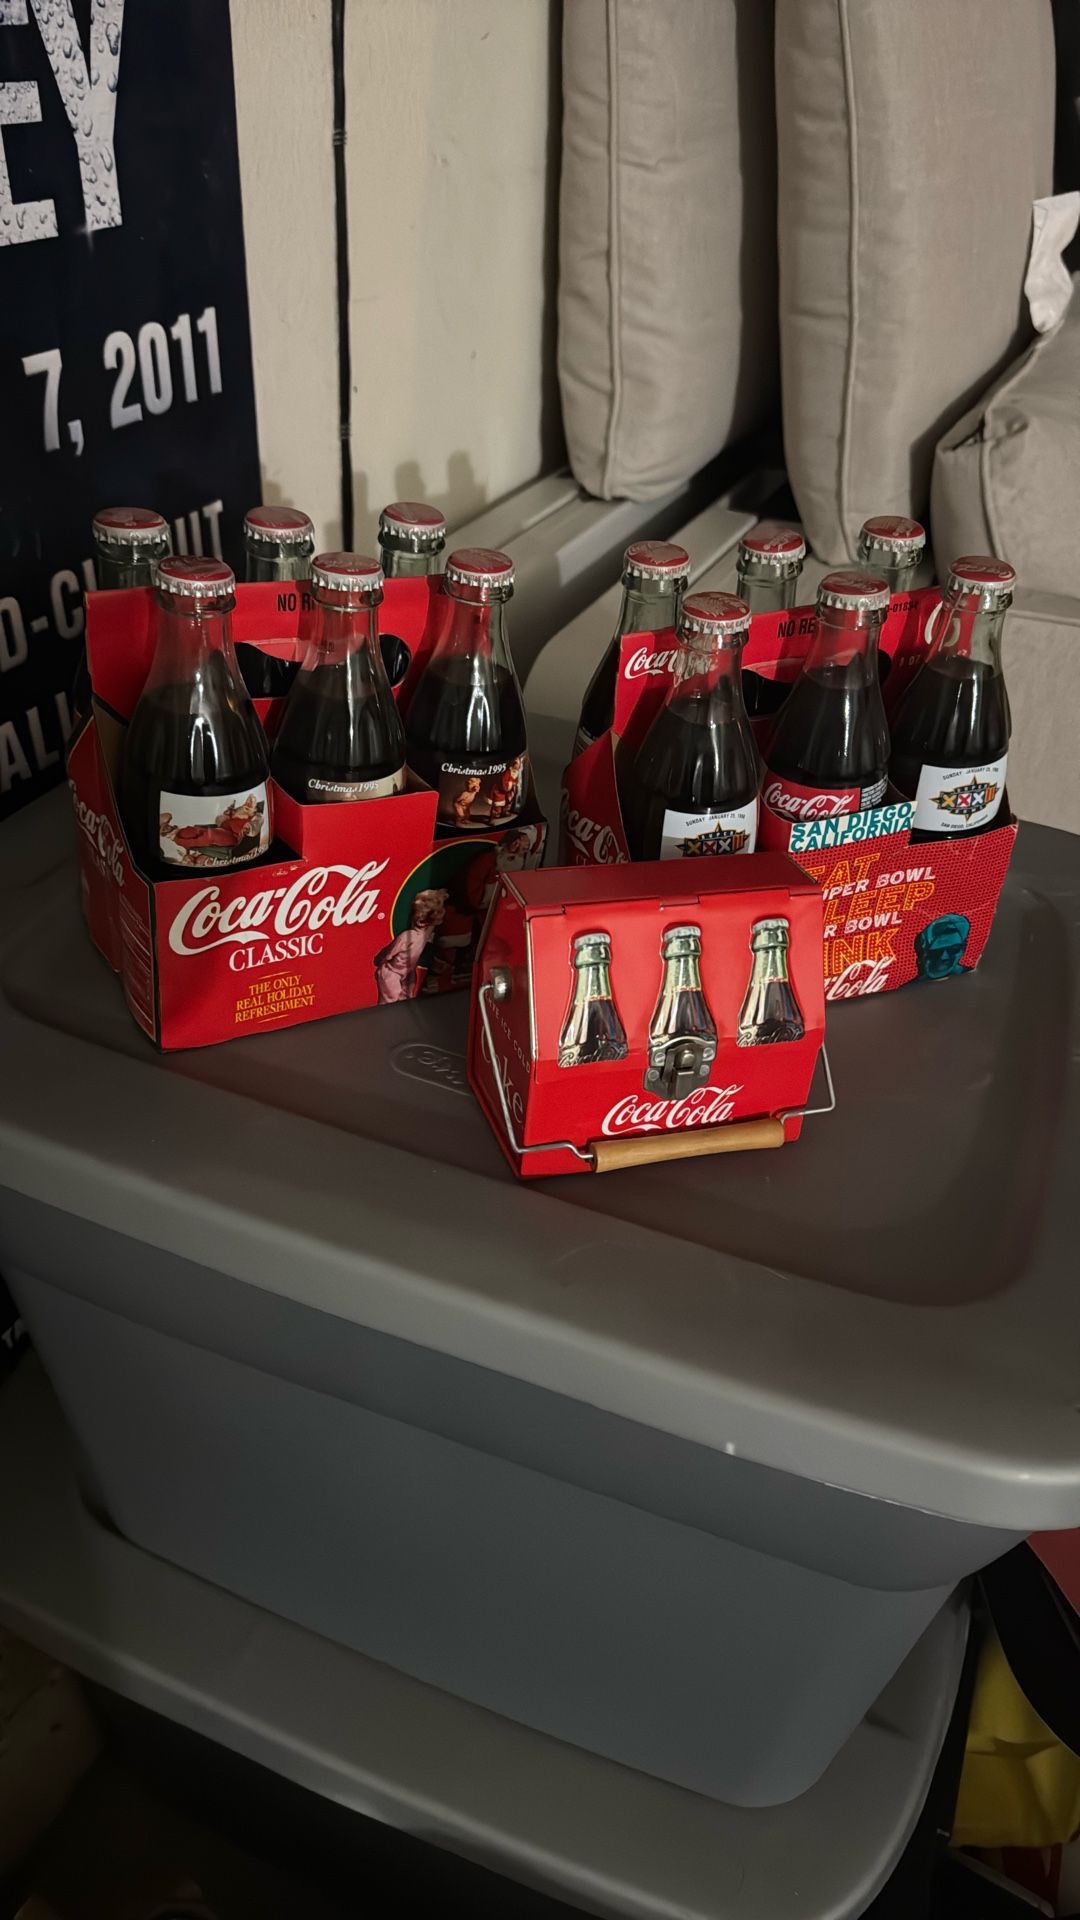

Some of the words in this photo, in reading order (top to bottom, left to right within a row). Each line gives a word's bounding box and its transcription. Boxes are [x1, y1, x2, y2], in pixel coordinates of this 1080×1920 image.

[21, 348, 85, 457] 7,
[103, 306, 223, 431] 2011
[277, 593, 297, 612] NO
[777, 619, 795, 638] NO
[441, 762, 488, 776] Christmas
[487, 763, 508, 775] 1995
[308, 778, 358, 793] Christmas
[685, 817, 705, 827] SUNDAY
[791, 816, 840, 840] SAN
[848, 801, 915, 829] DIEGO,
[790, 817, 912, 852] CALIFORNIA
[875, 866, 937, 888] BOWL
[168, 857, 391, 956] Coca-Cola
[844, 910, 903, 935] BOWL
[228, 933, 324, 973] CLASSIC
[237, 996, 265, 1010] REAL
[267, 983, 315, 1004] HOLIDAY
[249, 981, 272, 995] THE
[273, 975, 301, 992] ONLY
[235, 996, 316, 1023] REFRESHMENT
[601, 1084, 745, 1136] Coca-Cola
